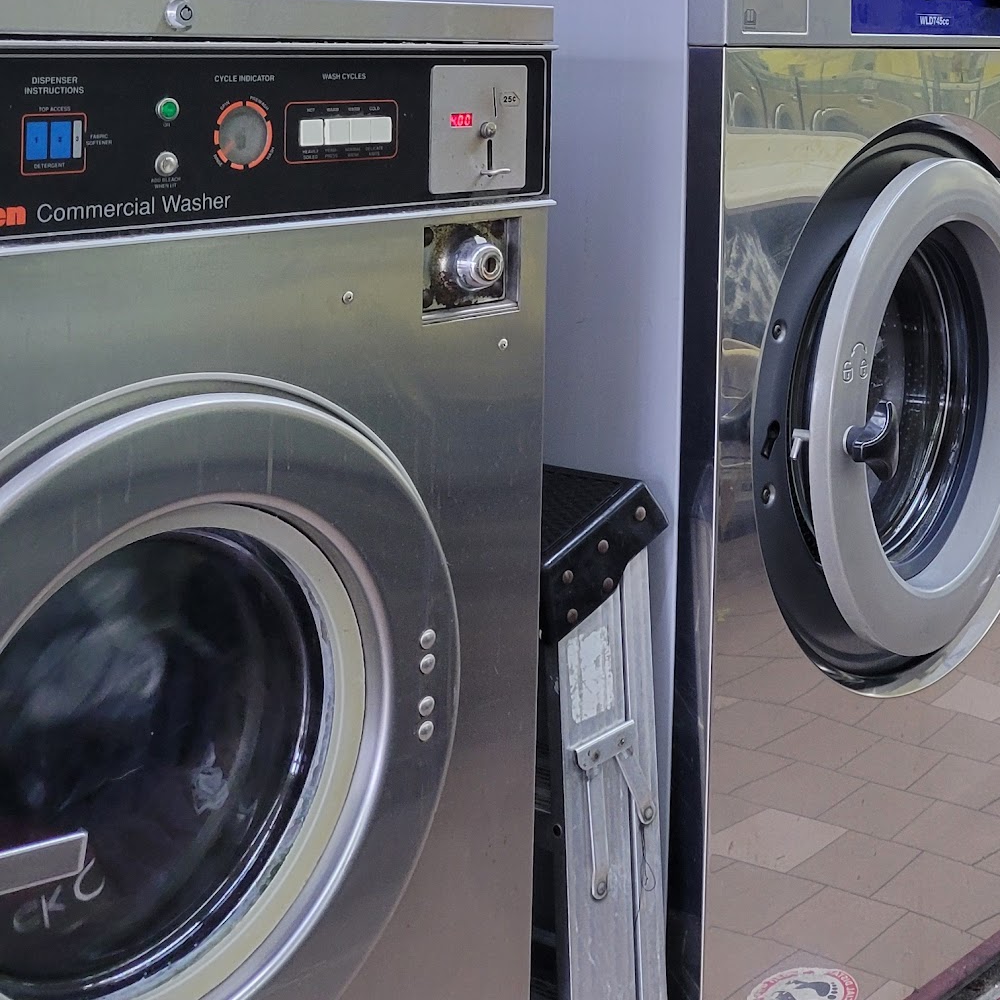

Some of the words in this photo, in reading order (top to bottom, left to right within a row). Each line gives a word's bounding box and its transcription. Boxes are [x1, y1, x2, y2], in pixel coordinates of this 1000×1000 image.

[31, 76, 79, 85] DISPENSER
[214, 74, 238, 83] CYCLE
[238, 74, 276, 82] INDICATOR
[322, 73, 341, 81] WASH
[341, 72, 367, 80] CYCLES
[24, 86, 85, 95] INSTRUCTIONS
[503, 95, 517, 103] 25¢
[85, 139, 113, 147] SOFTENER
[33, 162, 66, 170] DETERGENT
[37, 197, 155, 223] Commercial
[161, 193, 231, 213] Washer
